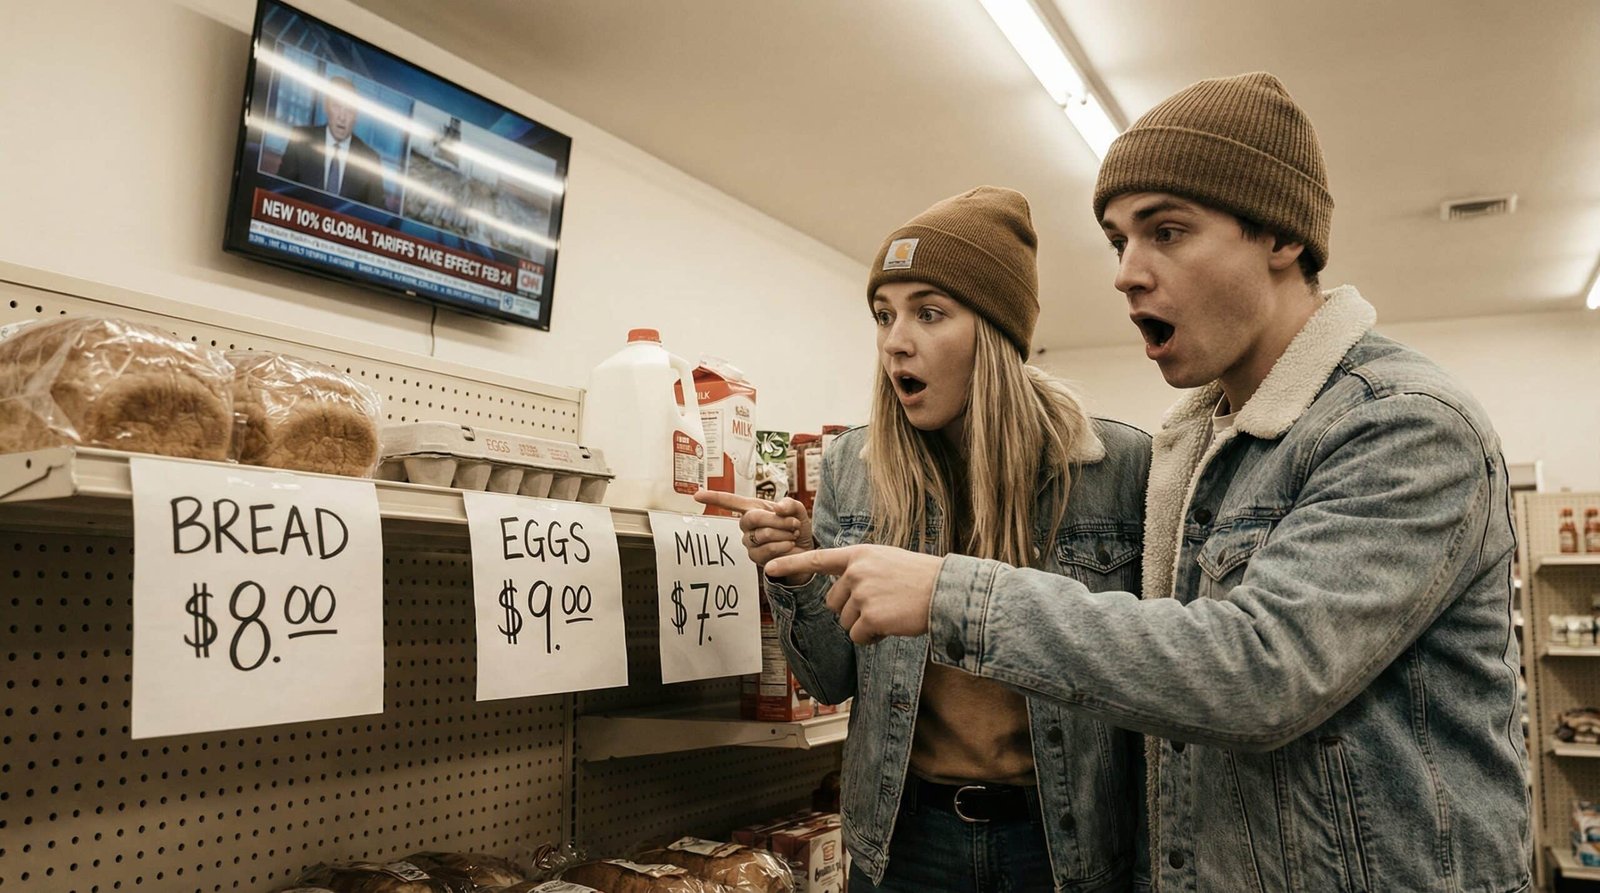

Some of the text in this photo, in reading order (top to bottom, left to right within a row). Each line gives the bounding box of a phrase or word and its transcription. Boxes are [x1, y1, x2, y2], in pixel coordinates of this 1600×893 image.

[262, 198, 512, 287] NEW 10% GLOBAL TARIFFS TAKE EFFECT FEB 24
[520, 276, 540, 291] CNN
[486, 438, 511, 454] EGGS
[732, 419, 753, 438] MILK
[170, 496, 349, 560] BREAD
[499, 516, 591, 565] EGGS
[674, 530, 736, 567] MILK
[184, 580, 338, 671] $8.00
[497, 578, 593, 654] $9.00
[671, 580, 739, 646] $7.00
